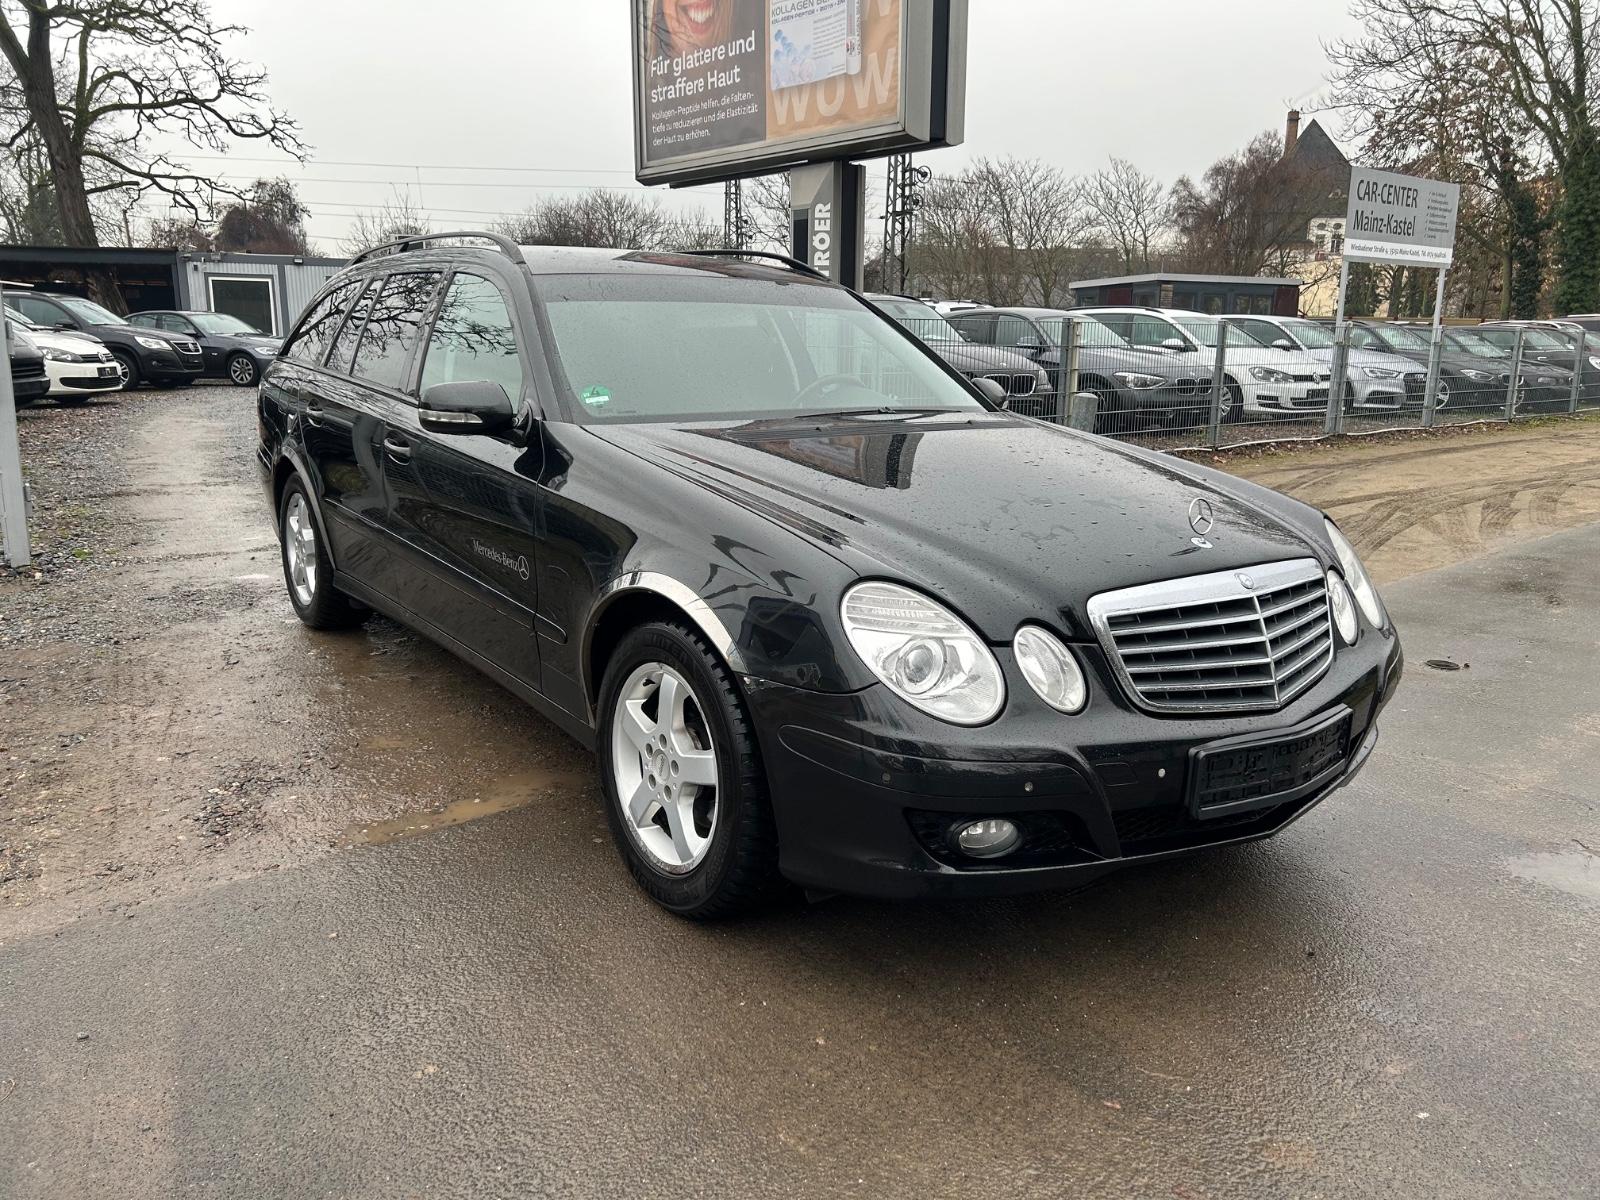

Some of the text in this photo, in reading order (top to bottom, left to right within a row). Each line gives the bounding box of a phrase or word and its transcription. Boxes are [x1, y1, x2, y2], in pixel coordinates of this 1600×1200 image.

[772, 0, 814, 18] KOLLAGEN
[650, 30, 755, 77] Für glattere und
[651, 65, 741, 103] straffere Haut
[720, 95, 730, 106] die
[703, 111, 716, 123] und
[716, 109, 726, 121] die
[652, 136, 663, 147] der
[663, 134, 677, 145] Haut
[1356, 179, 1419, 209] CAR-CENTER
[1352, 209, 1417, 237] Mainz-Kastel
